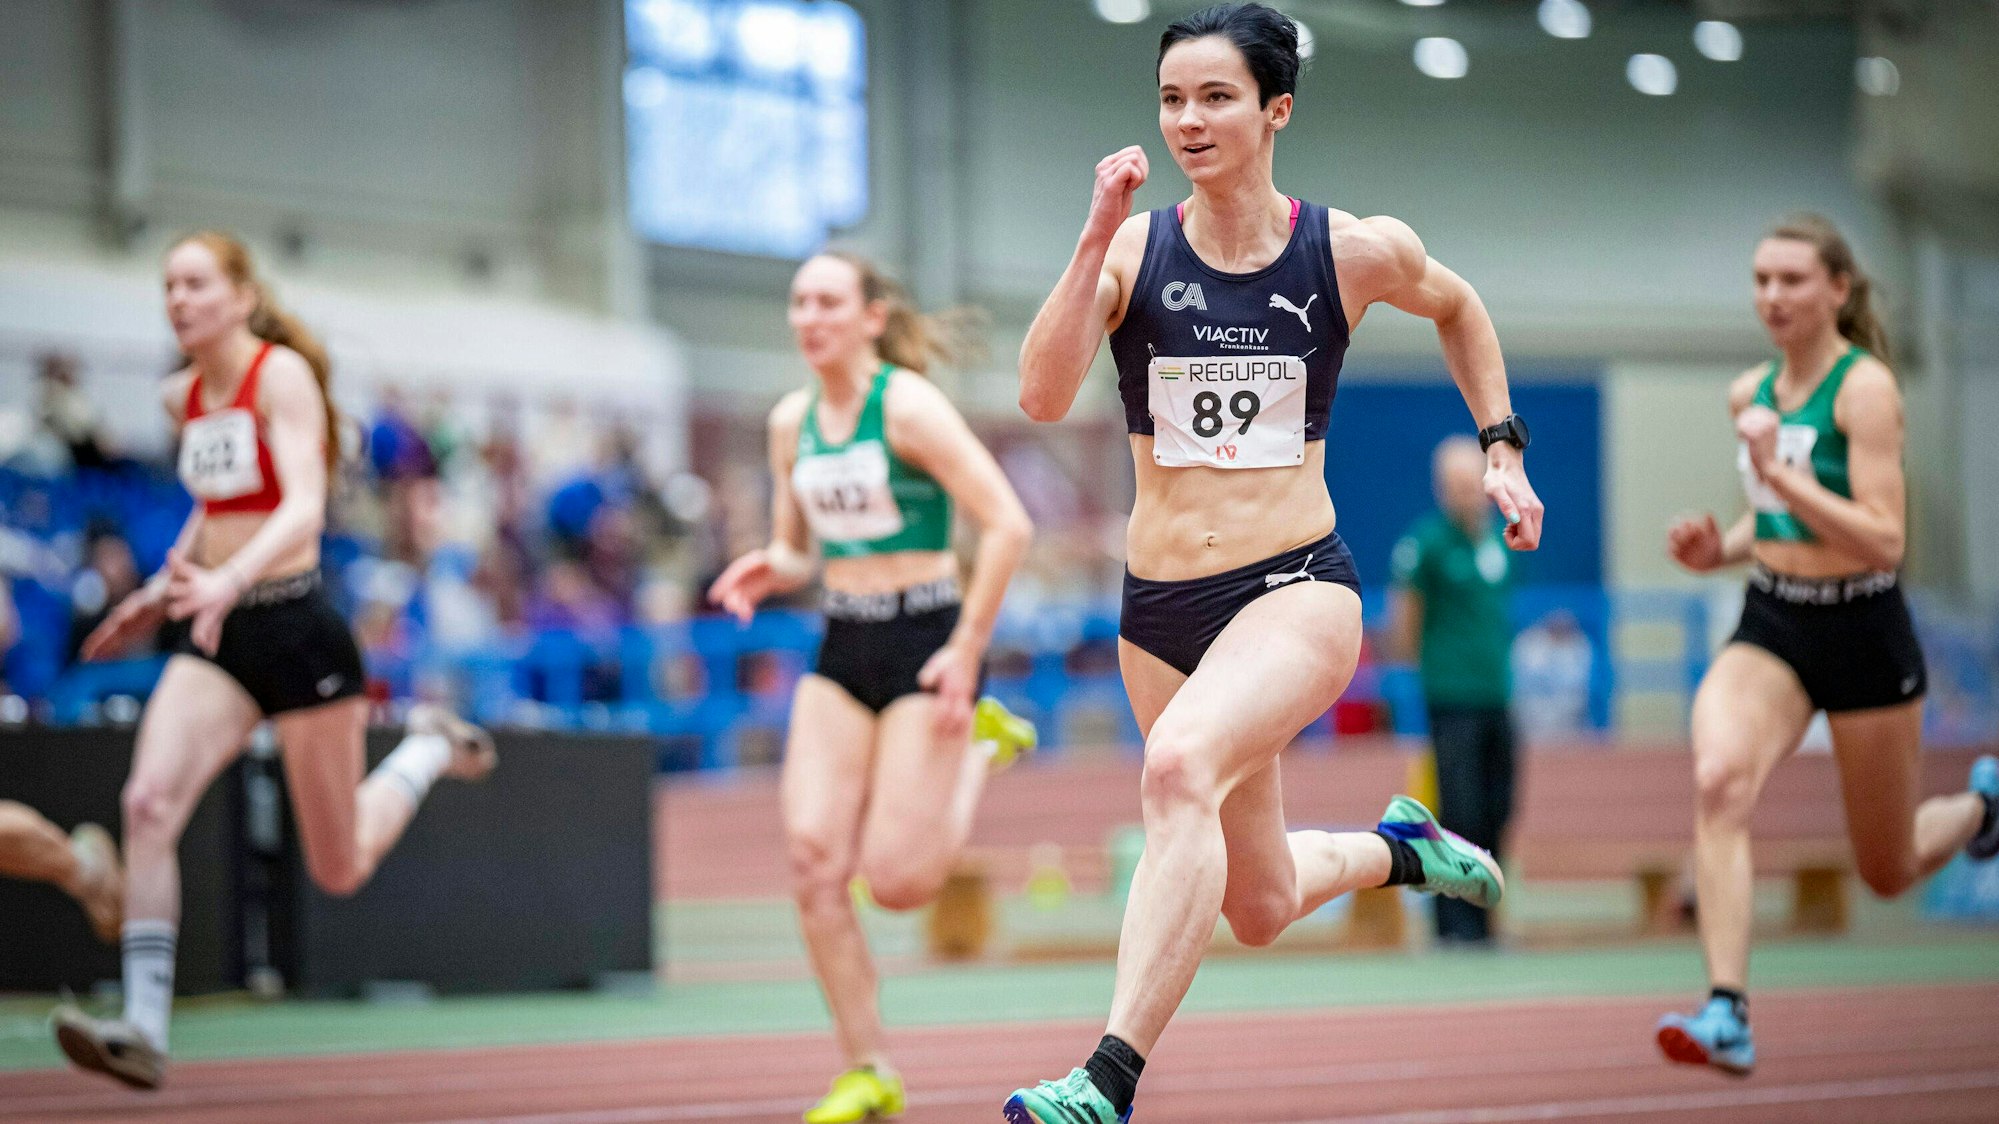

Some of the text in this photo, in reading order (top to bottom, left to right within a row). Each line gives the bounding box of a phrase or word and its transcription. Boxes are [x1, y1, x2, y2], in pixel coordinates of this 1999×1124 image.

[1161, 281, 1208, 311] CA
[1192, 325, 1269, 343] VIACTIV
[1219, 342, 1269, 351] Krankenkasse
[1189, 361, 1297, 382] REGUPOL
[1192, 390, 1260, 438] 89
